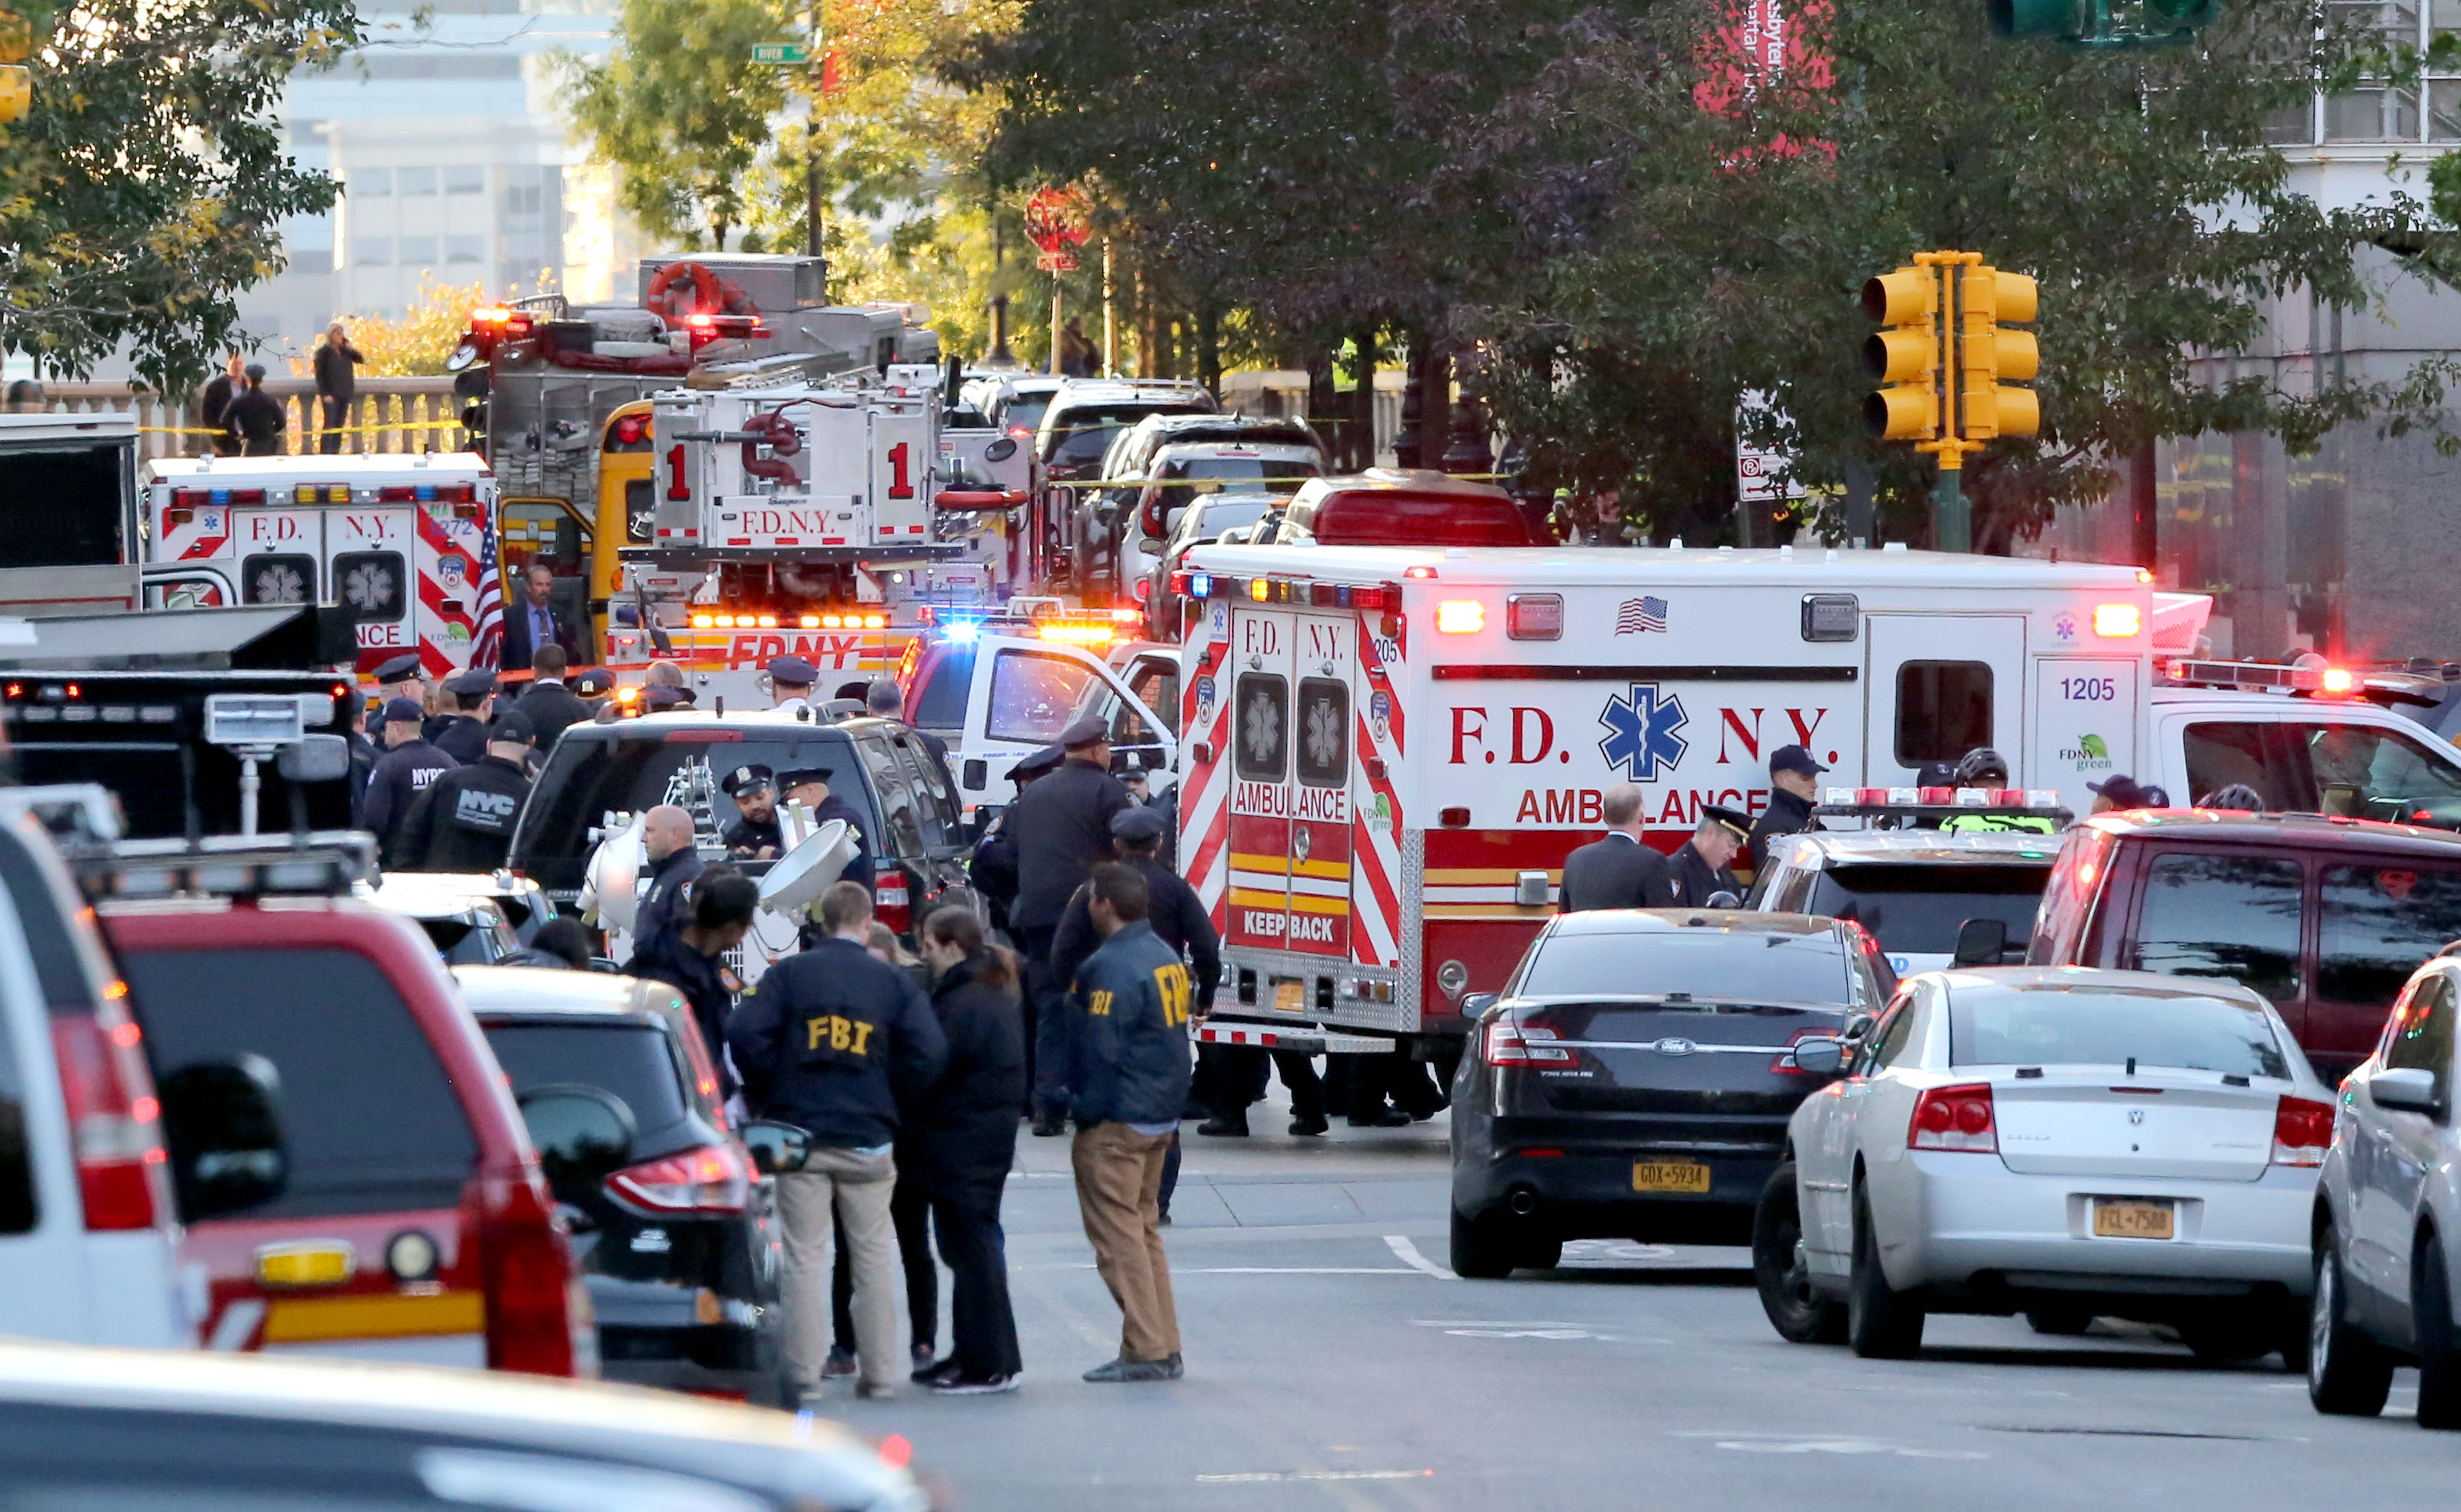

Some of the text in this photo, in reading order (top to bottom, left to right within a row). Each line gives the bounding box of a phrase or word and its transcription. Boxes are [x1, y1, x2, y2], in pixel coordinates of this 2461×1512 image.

[667, 444, 690, 500] 1
[888, 442, 914, 499] 1
[252, 515, 395, 541] F.D. N.Y.
[429, 520, 473, 536] 1272
[742, 510, 835, 534] F.D.N.Y.
[729, 635, 859, 671] FDNY
[1245, 619, 1343, 660] F.D. N.Y.
[2060, 677, 2115, 701] 1205
[1448, 706, 1839, 764] F.D. NY.
[2060, 749, 2095, 760] FDNY
[2077, 759, 2112, 772] green
[458, 789, 516, 816] NYC
[1235, 782, 1346, 821] AMBULANCE
[1516, 789, 1768, 824] AMBANCE
[1243, 910, 1334, 943] KEEP BACK
[807, 1014, 873, 1056] FBI
